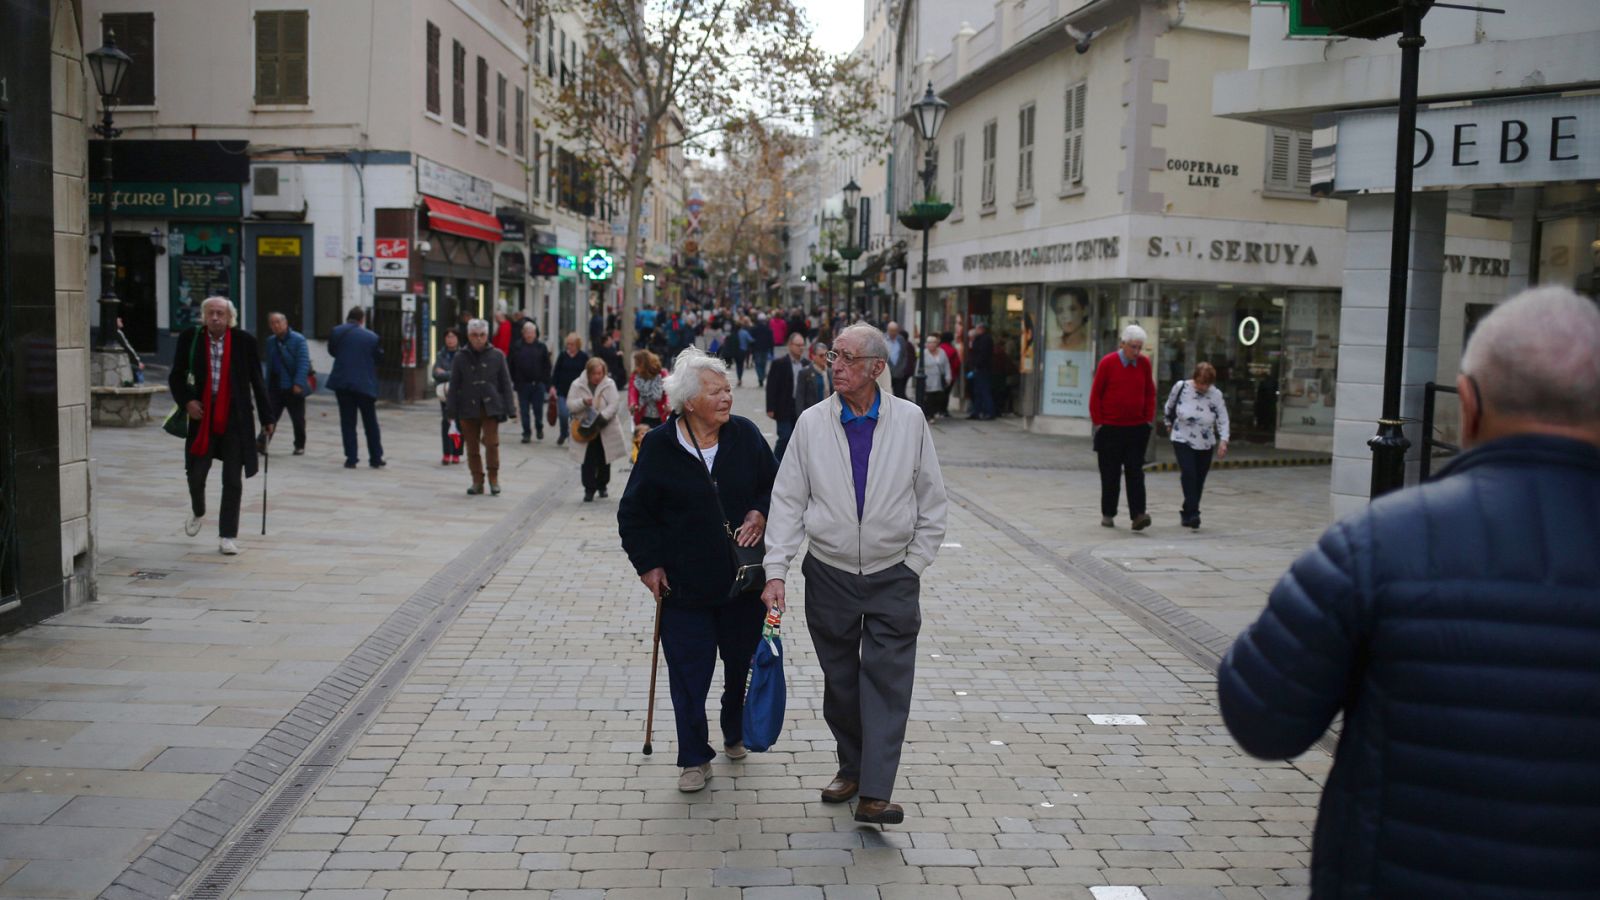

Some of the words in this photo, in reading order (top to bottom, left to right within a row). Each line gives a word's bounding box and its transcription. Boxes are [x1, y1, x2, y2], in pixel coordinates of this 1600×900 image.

[1, 77, 9, 102] 1
[1167, 158, 1240, 177] COOPERAGE
[1188, 174, 1220, 188] LANE
[173, 188, 211, 208] Inn
[1075, 236, 1119, 261] CENTRE
[1210, 240, 1319, 267] SERUYA
[1051, 398, 1083, 406] CHANEL
